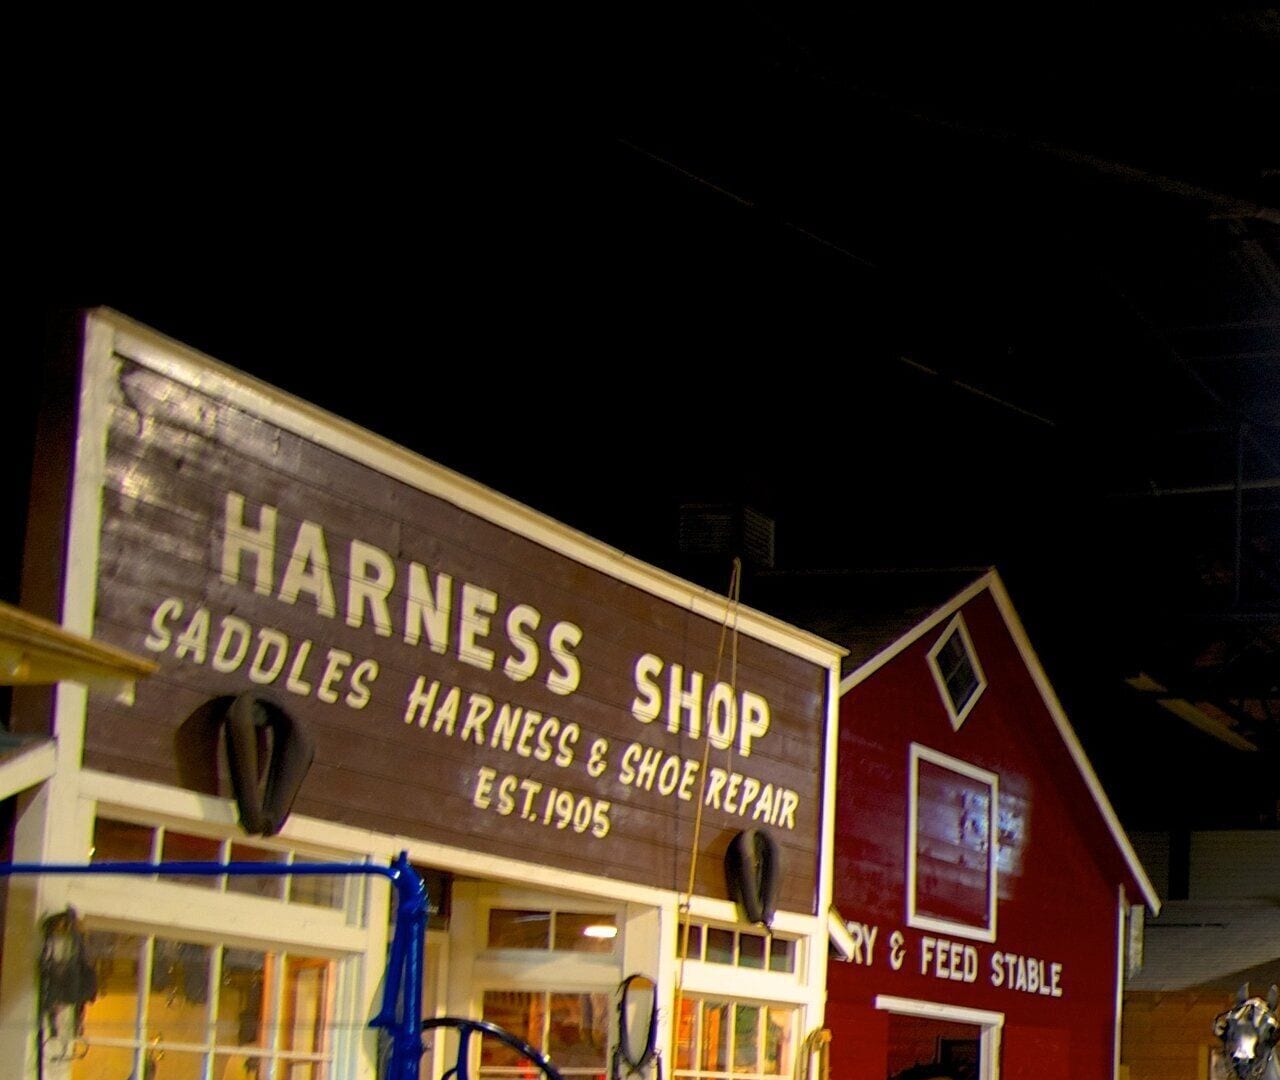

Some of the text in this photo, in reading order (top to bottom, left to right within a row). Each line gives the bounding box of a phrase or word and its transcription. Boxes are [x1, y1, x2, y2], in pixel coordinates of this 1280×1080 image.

[144, 597, 799, 830] SADDLES HARNESS & SHOE REPAIR
[220, 490, 771, 756] HARNESS SHOP
[889, 930, 906, 971] &
[921, 936, 978, 983] FEED
[990, 951, 1063, 997] STABLE
